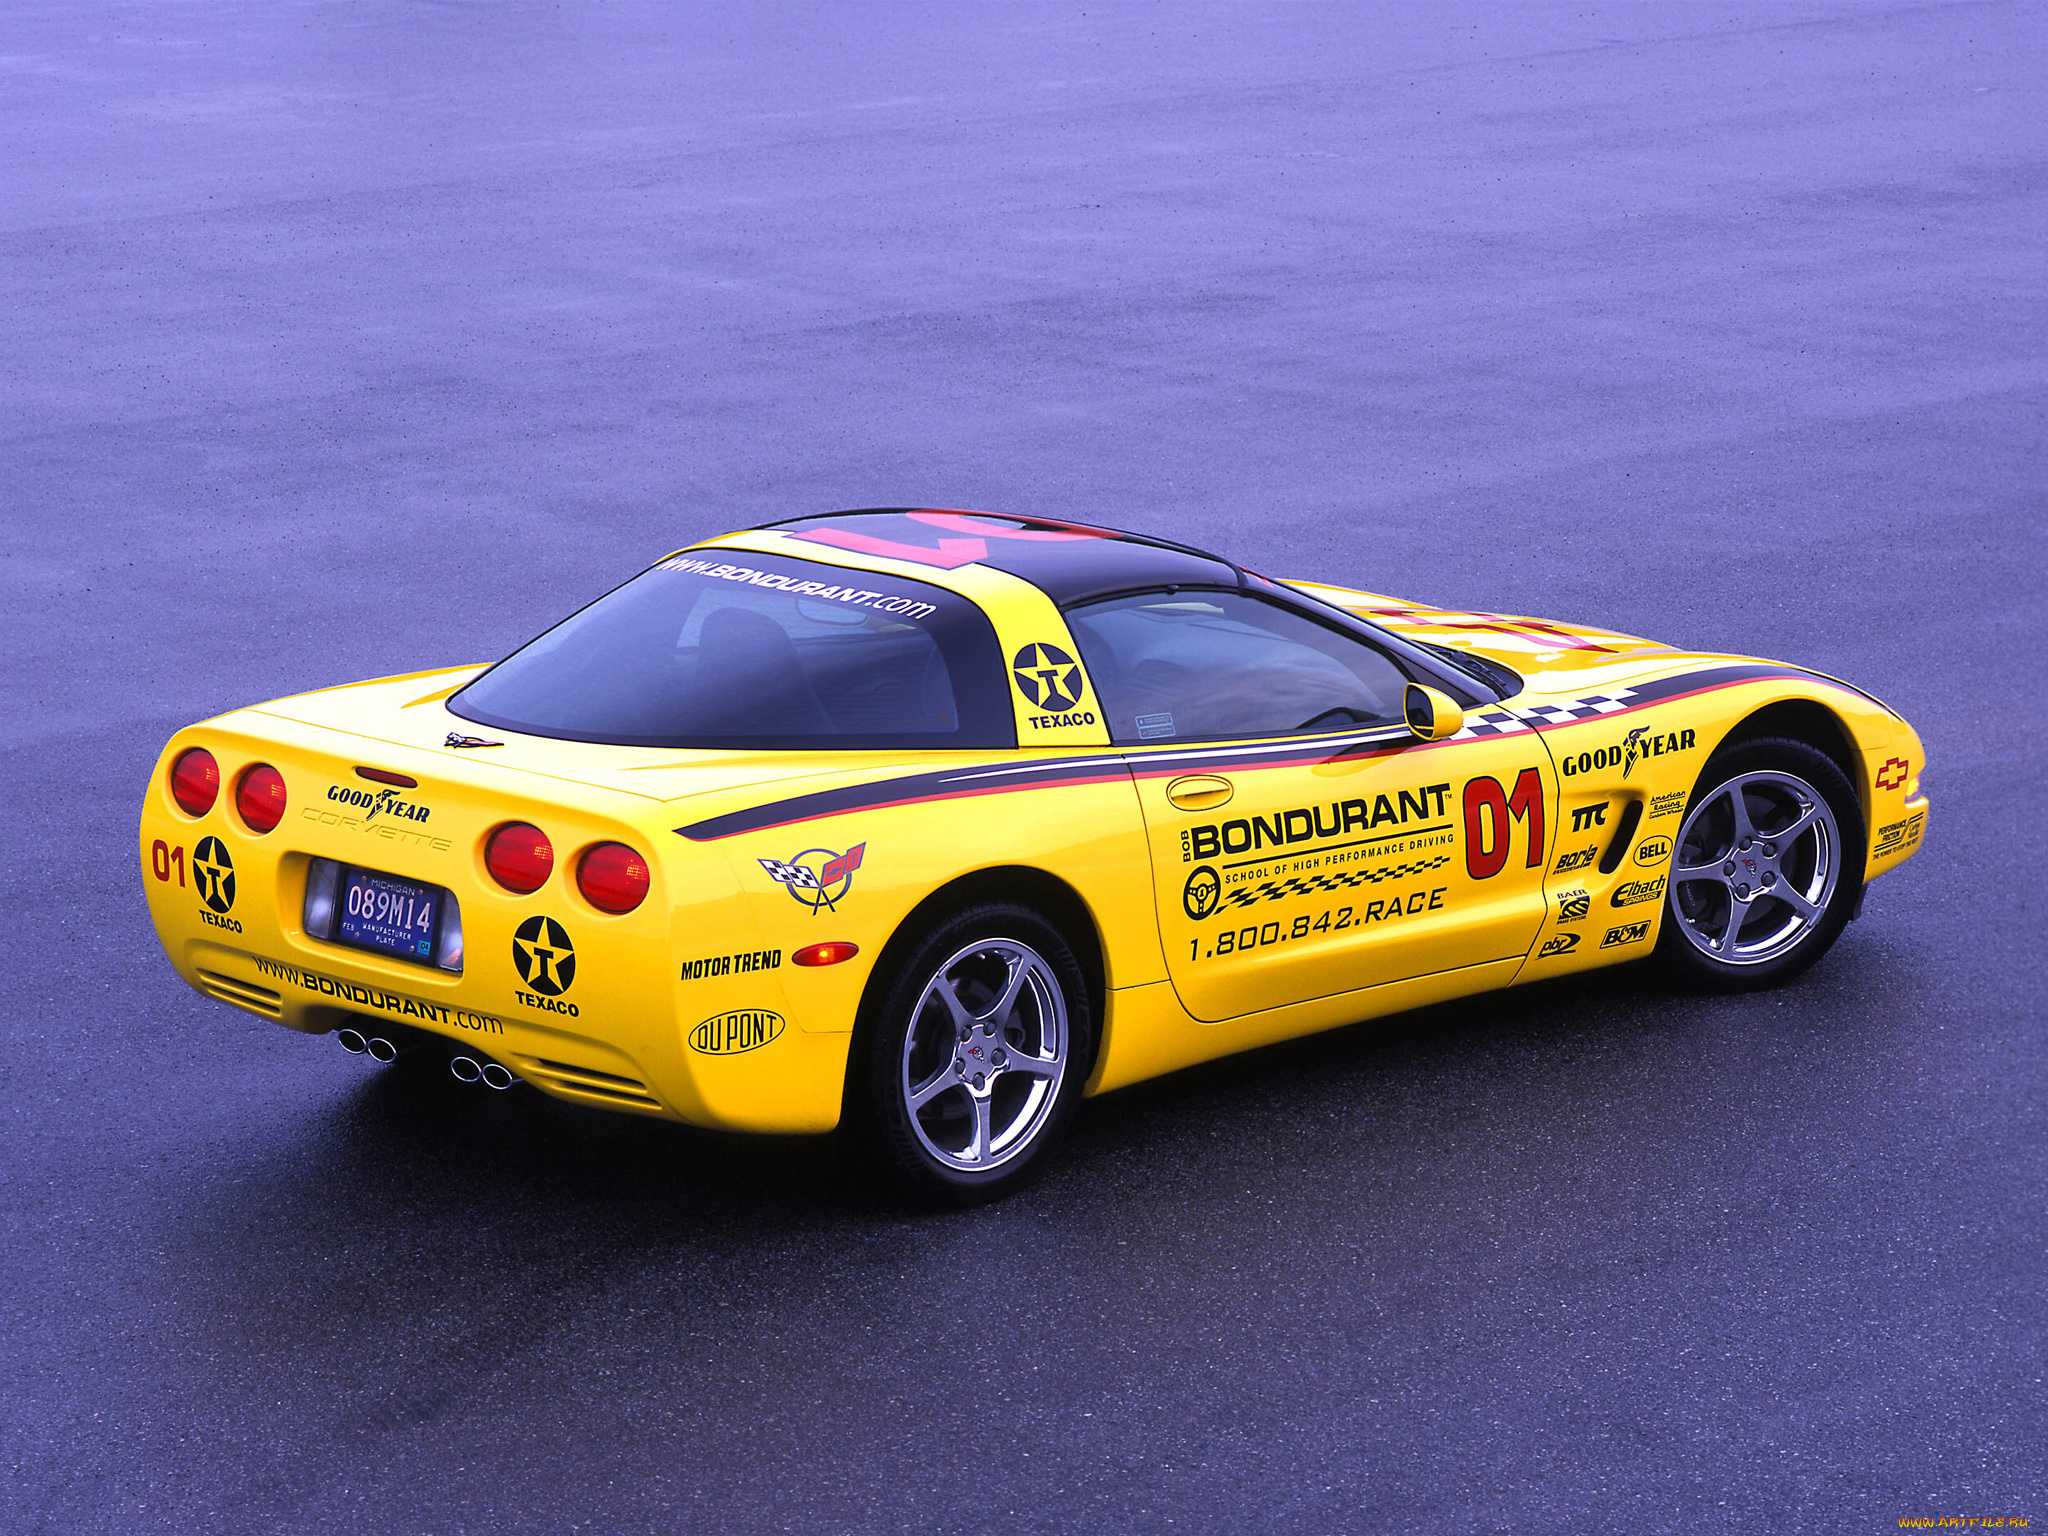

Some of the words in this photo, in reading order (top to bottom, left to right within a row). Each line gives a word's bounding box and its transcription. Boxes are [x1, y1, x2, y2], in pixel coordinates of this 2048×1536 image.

[1028, 711, 1096, 730] TEXACO
[300, 807, 453, 852] CORVETTE
[1190, 783, 1451, 861] BONDURANT
[1462, 767, 1545, 880] 01
[1180, 830, 1191, 862] BOB
[1225, 869, 1269, 884] SCHOOL
[1274, 865, 1288, 876] OF
[1293, 858, 1320, 872] HIGH
[1325, 842, 1405, 865] PERFORMANCE
[1409, 833, 1455, 851] DRIVING
[1639, 841, 1668, 861] BELL
[152, 839, 186, 888] 01
[371, 879, 416, 896] MICHIGAN
[1557, 889, 1587, 899] BAER
[1610, 874, 1666, 908] Eibach
[1622, 892, 1658, 906] SPRINGS
[199, 909, 243, 934] TEXACO
[348, 886, 431, 933] 089M14
[342, 922, 355, 932] FEB
[362, 922, 412, 941] MANUFACTURER
[1190, 887, 1448, 962] 1.800.842.RACE
[1603, 922, 1648, 946] B&M
[375, 935, 396, 946] PLATE
[420, 941, 429, 950] 04
[681, 955, 730, 981] MOTOR
[734, 949, 781, 973] TREND
[252, 955, 504, 1035] www.BONDURANT.com
[515, 990, 579, 1018] TEXACO
